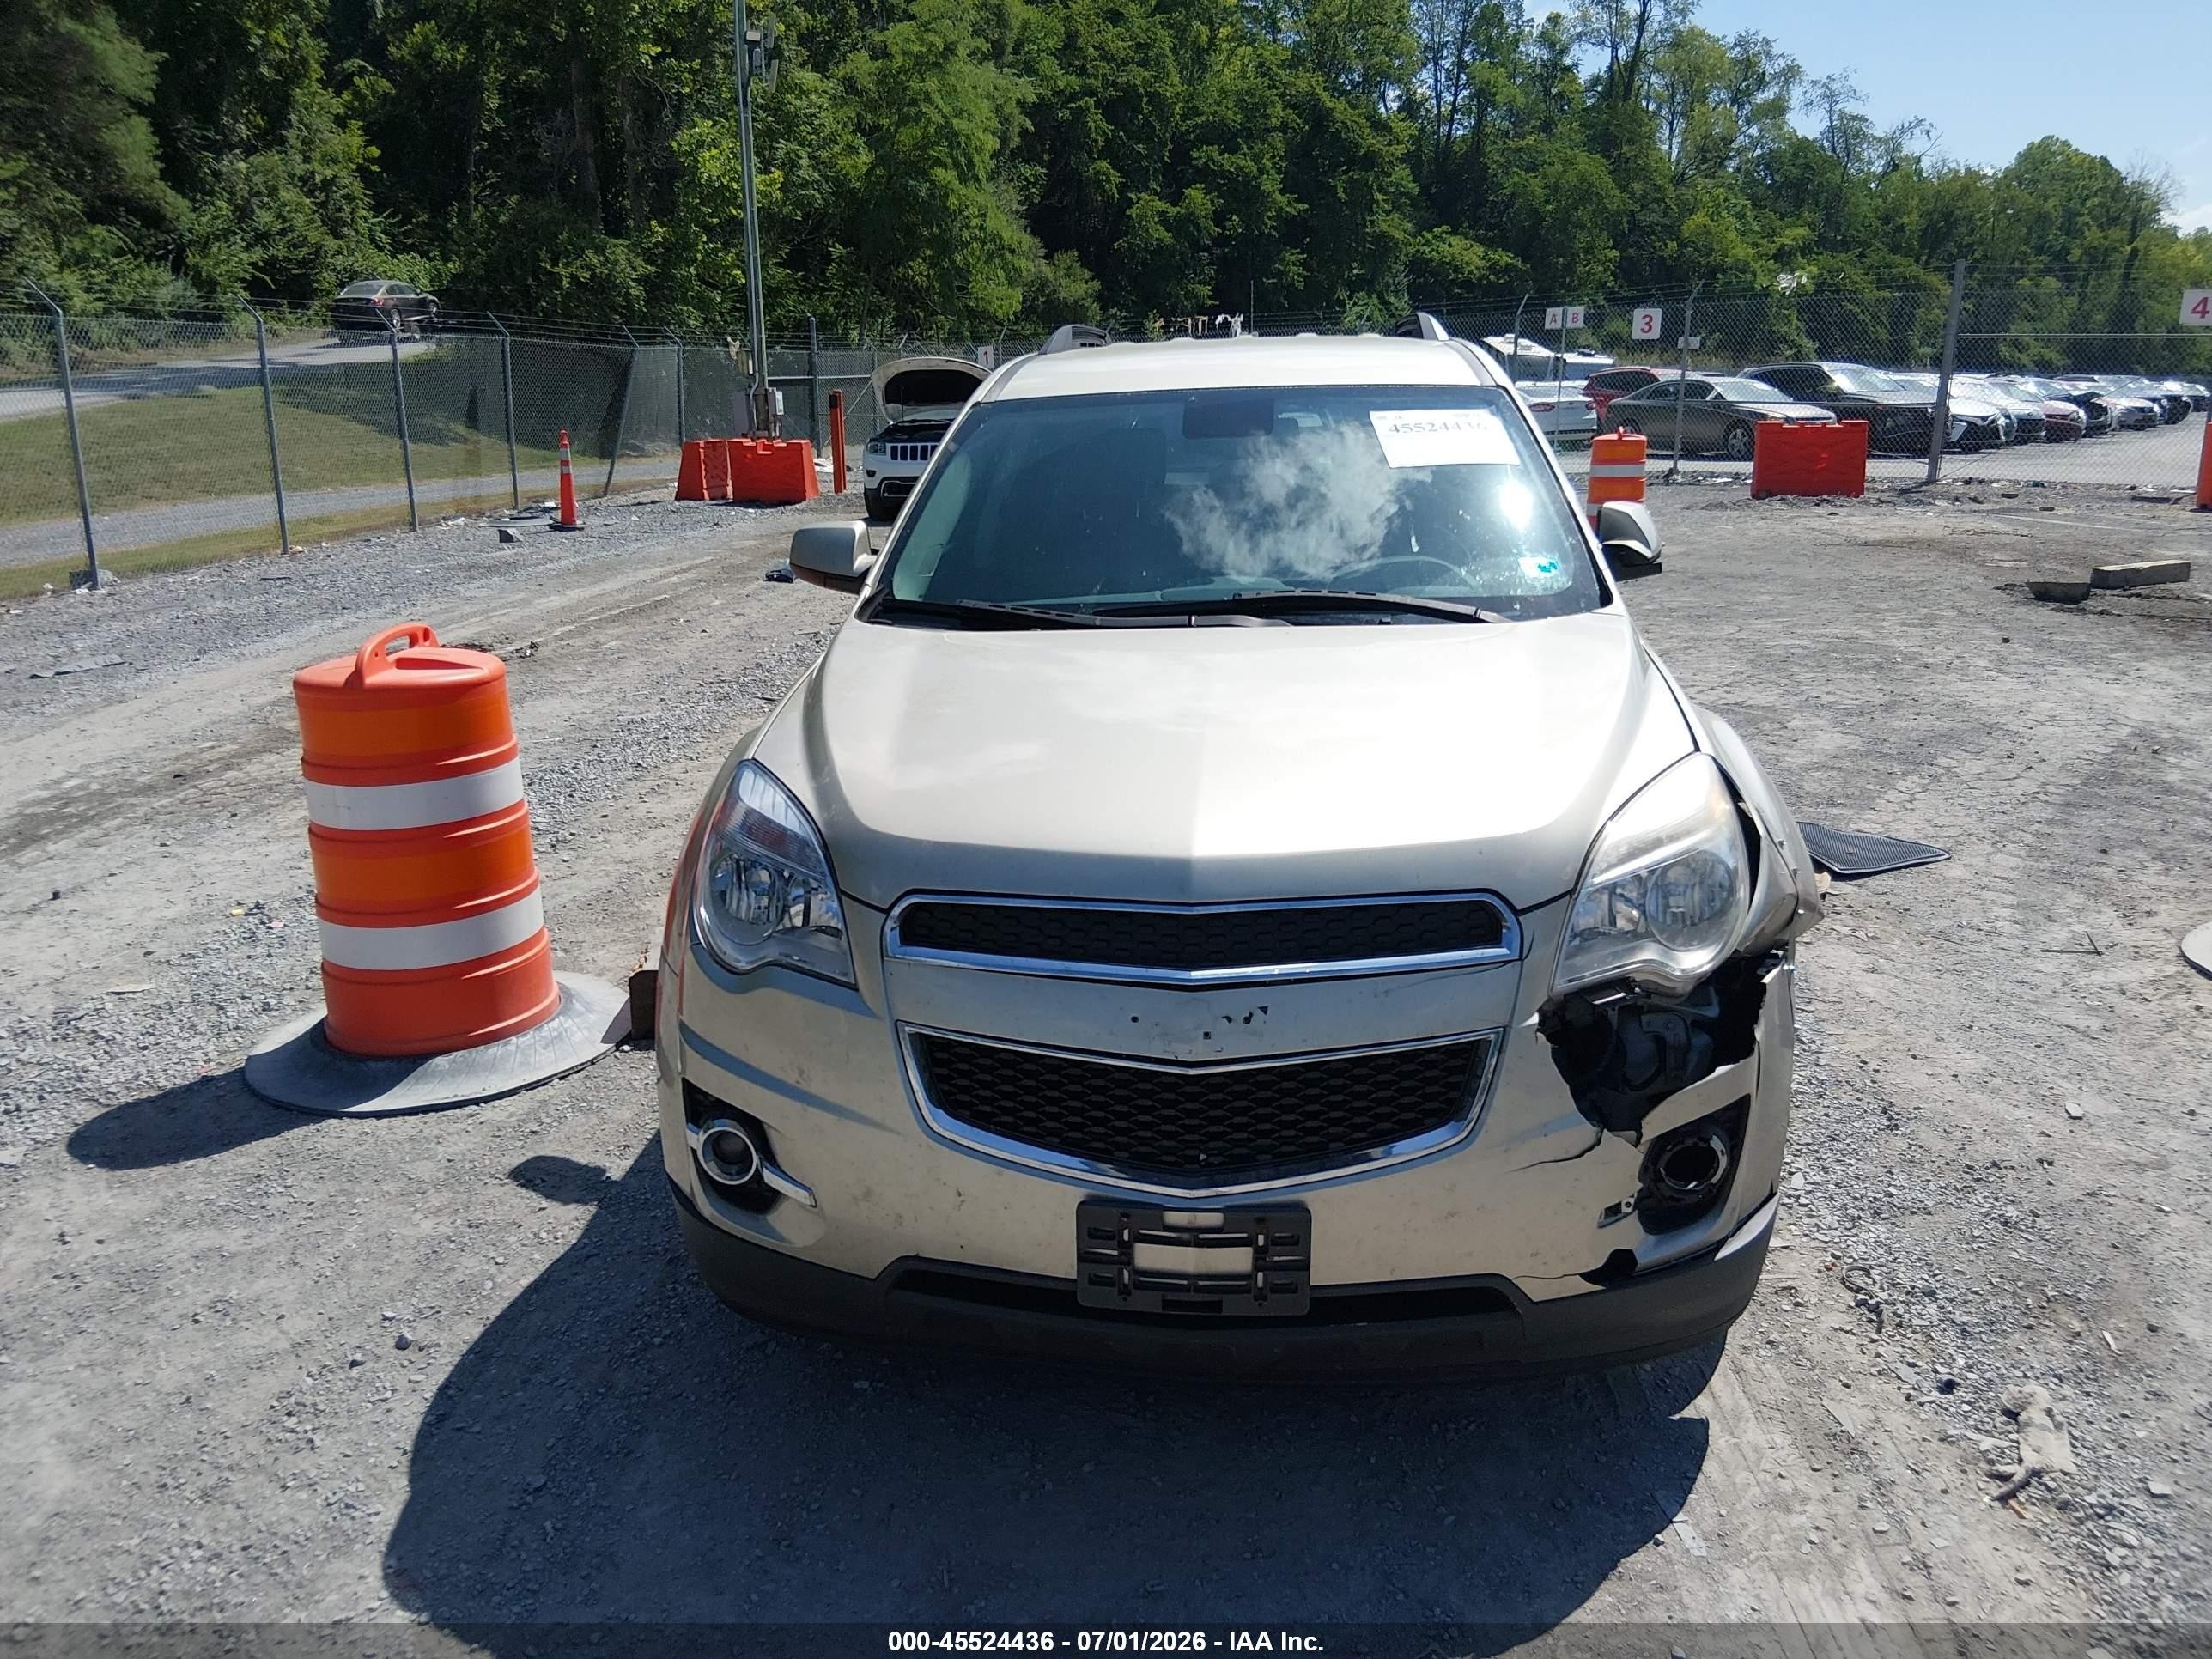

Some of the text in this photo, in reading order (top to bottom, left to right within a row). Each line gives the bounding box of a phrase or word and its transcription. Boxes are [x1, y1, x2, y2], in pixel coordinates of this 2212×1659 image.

[2191, 296, 2209, 319] 4
[1549, 313, 1557, 325] A
[1571, 312, 1579, 324] B
[1640, 314, 1653, 333] 3
[983, 350, 988, 365] 1
